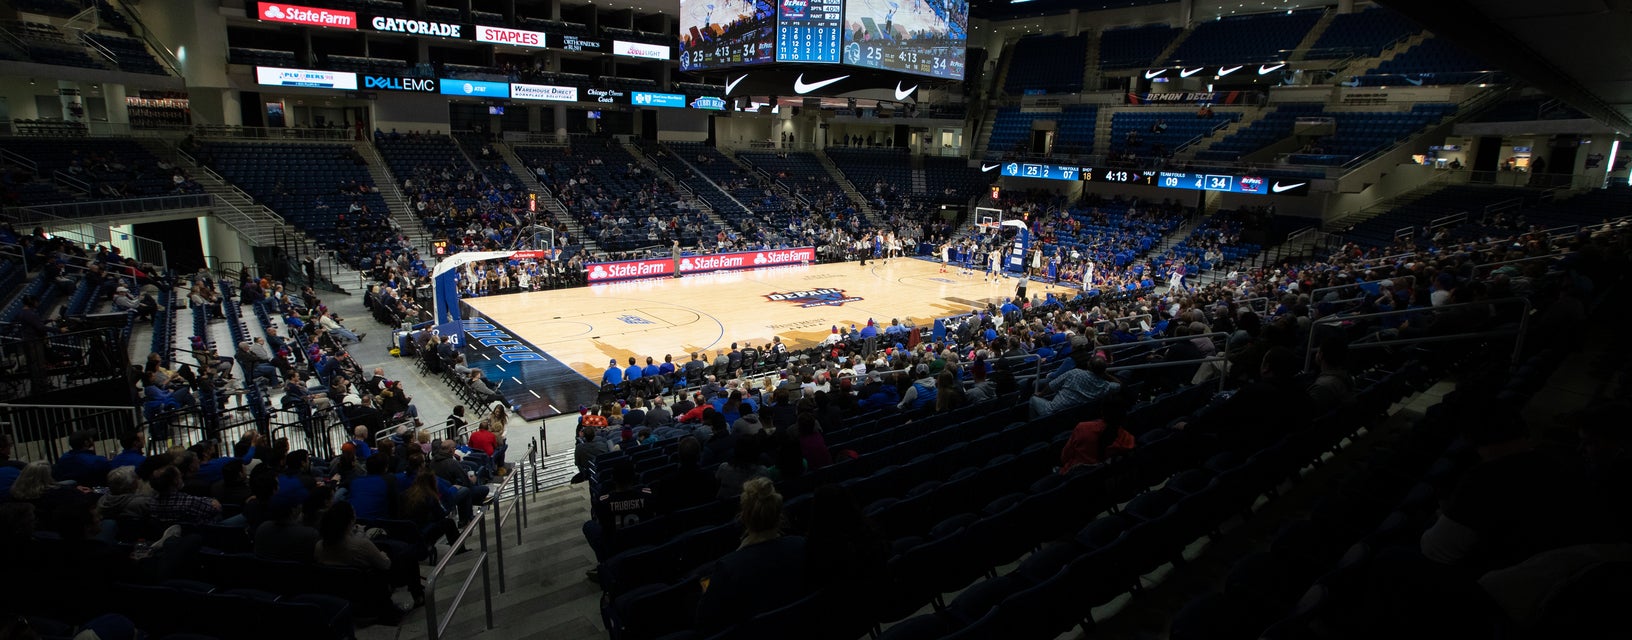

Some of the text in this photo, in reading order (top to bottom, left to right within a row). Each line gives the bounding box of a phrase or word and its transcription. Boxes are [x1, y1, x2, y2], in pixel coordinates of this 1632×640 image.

[372, 16, 461, 38] GATORADE
[485, 29, 538, 45] STAPLES
[715, 46, 730, 58] 4:13
[743, 43, 756, 56] 34
[867, 47, 882, 60] 25
[693, 50, 704, 62] 25
[899, 51, 917, 63] 4:13
[933, 57, 946, 70] 34
[403, 78, 434, 92] EMC
[1146, 92, 1216, 101] DEMON DECK
[1027, 166, 1038, 175] 25
[1043, 169, 1049, 178] 2
[1064, 170, 1073, 179] 07
[1083, 172, 1092, 180] 18
[1106, 171, 1127, 181] 4:13
[1166, 177, 1178, 187] 09
[1195, 179, 1202, 188] 4
[1211, 177, 1226, 188] 34
